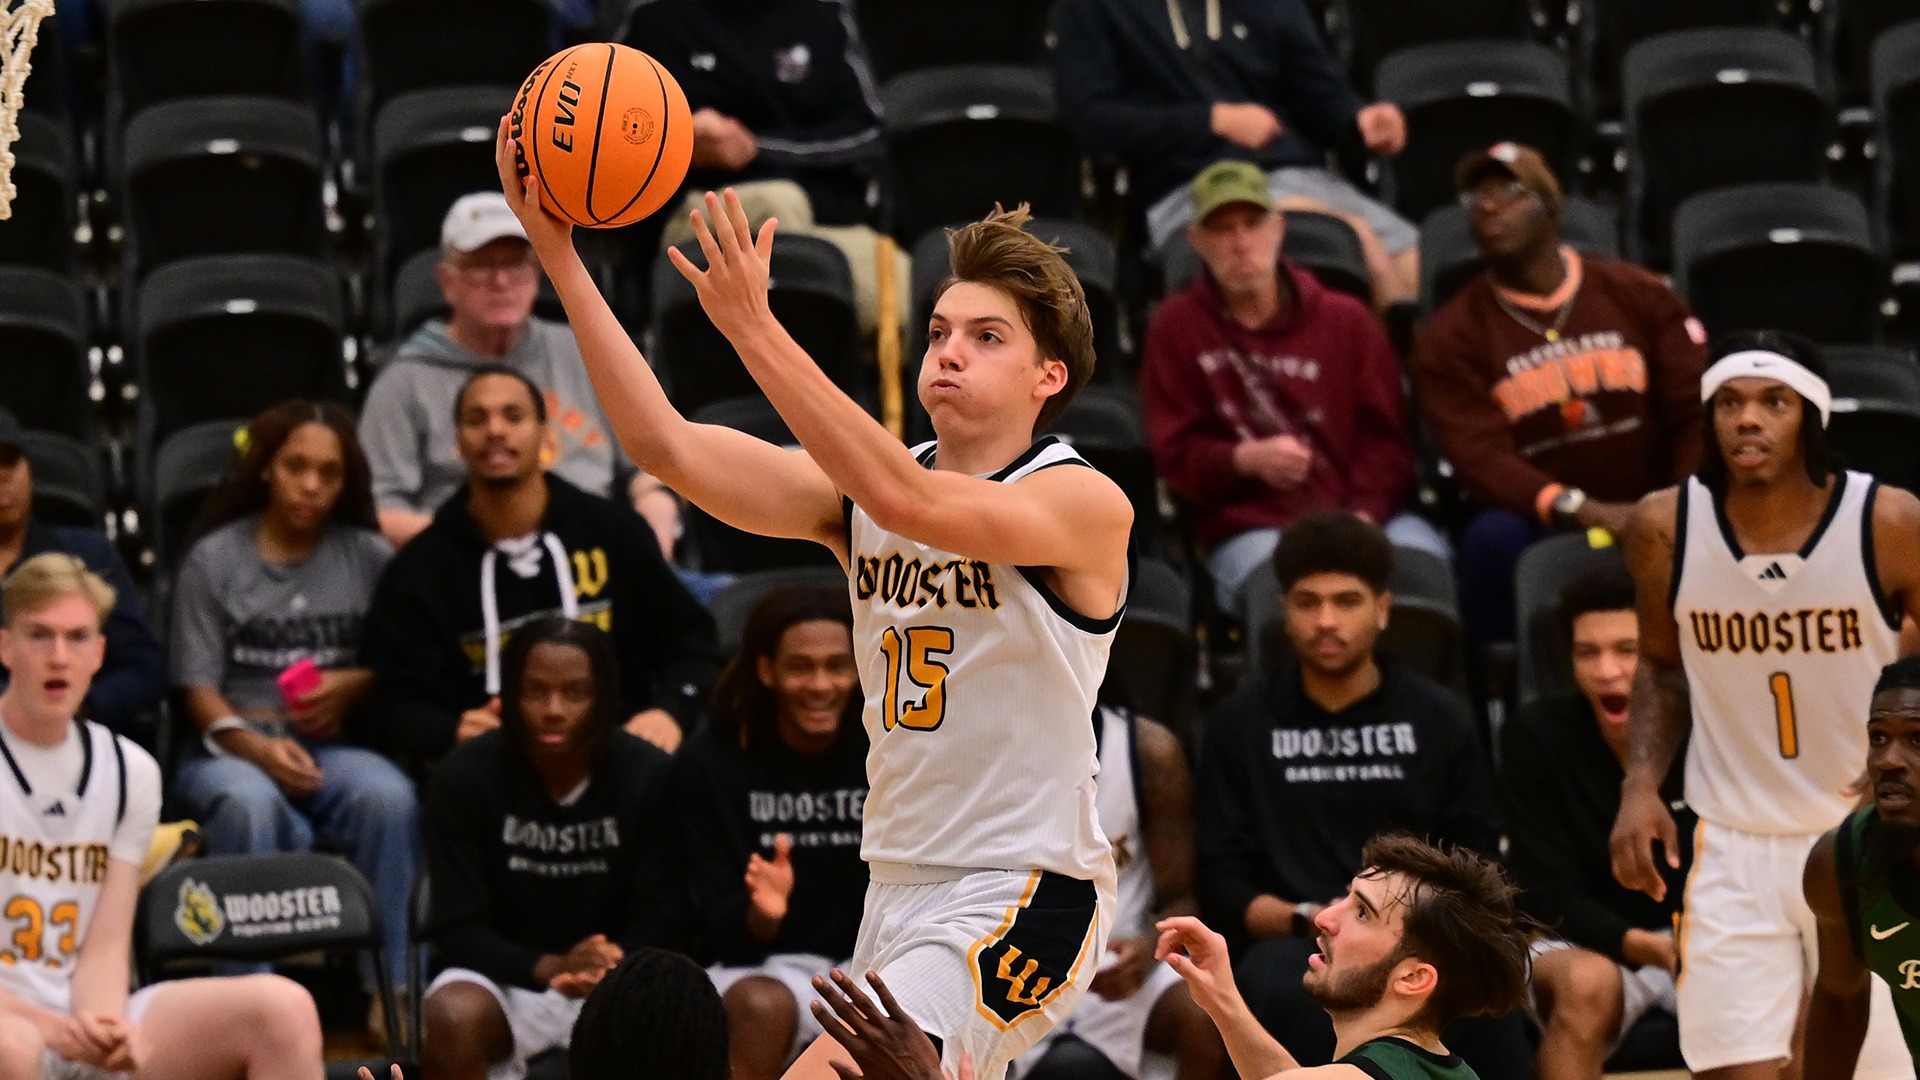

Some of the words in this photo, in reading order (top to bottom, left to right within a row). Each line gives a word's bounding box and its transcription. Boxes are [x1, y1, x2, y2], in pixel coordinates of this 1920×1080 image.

[552, 80, 582, 153] EVO
[856, 552, 1003, 612] WOOSTER
[1689, 607, 1863, 655] WOOSTER
[880, 625, 955, 733] 15
[1272, 722, 1417, 759] WOOSTER
[1768, 671, 1799, 760] 1
[749, 789, 868, 823] WOOSTE
[224, 884, 342, 924] WOOSTER
